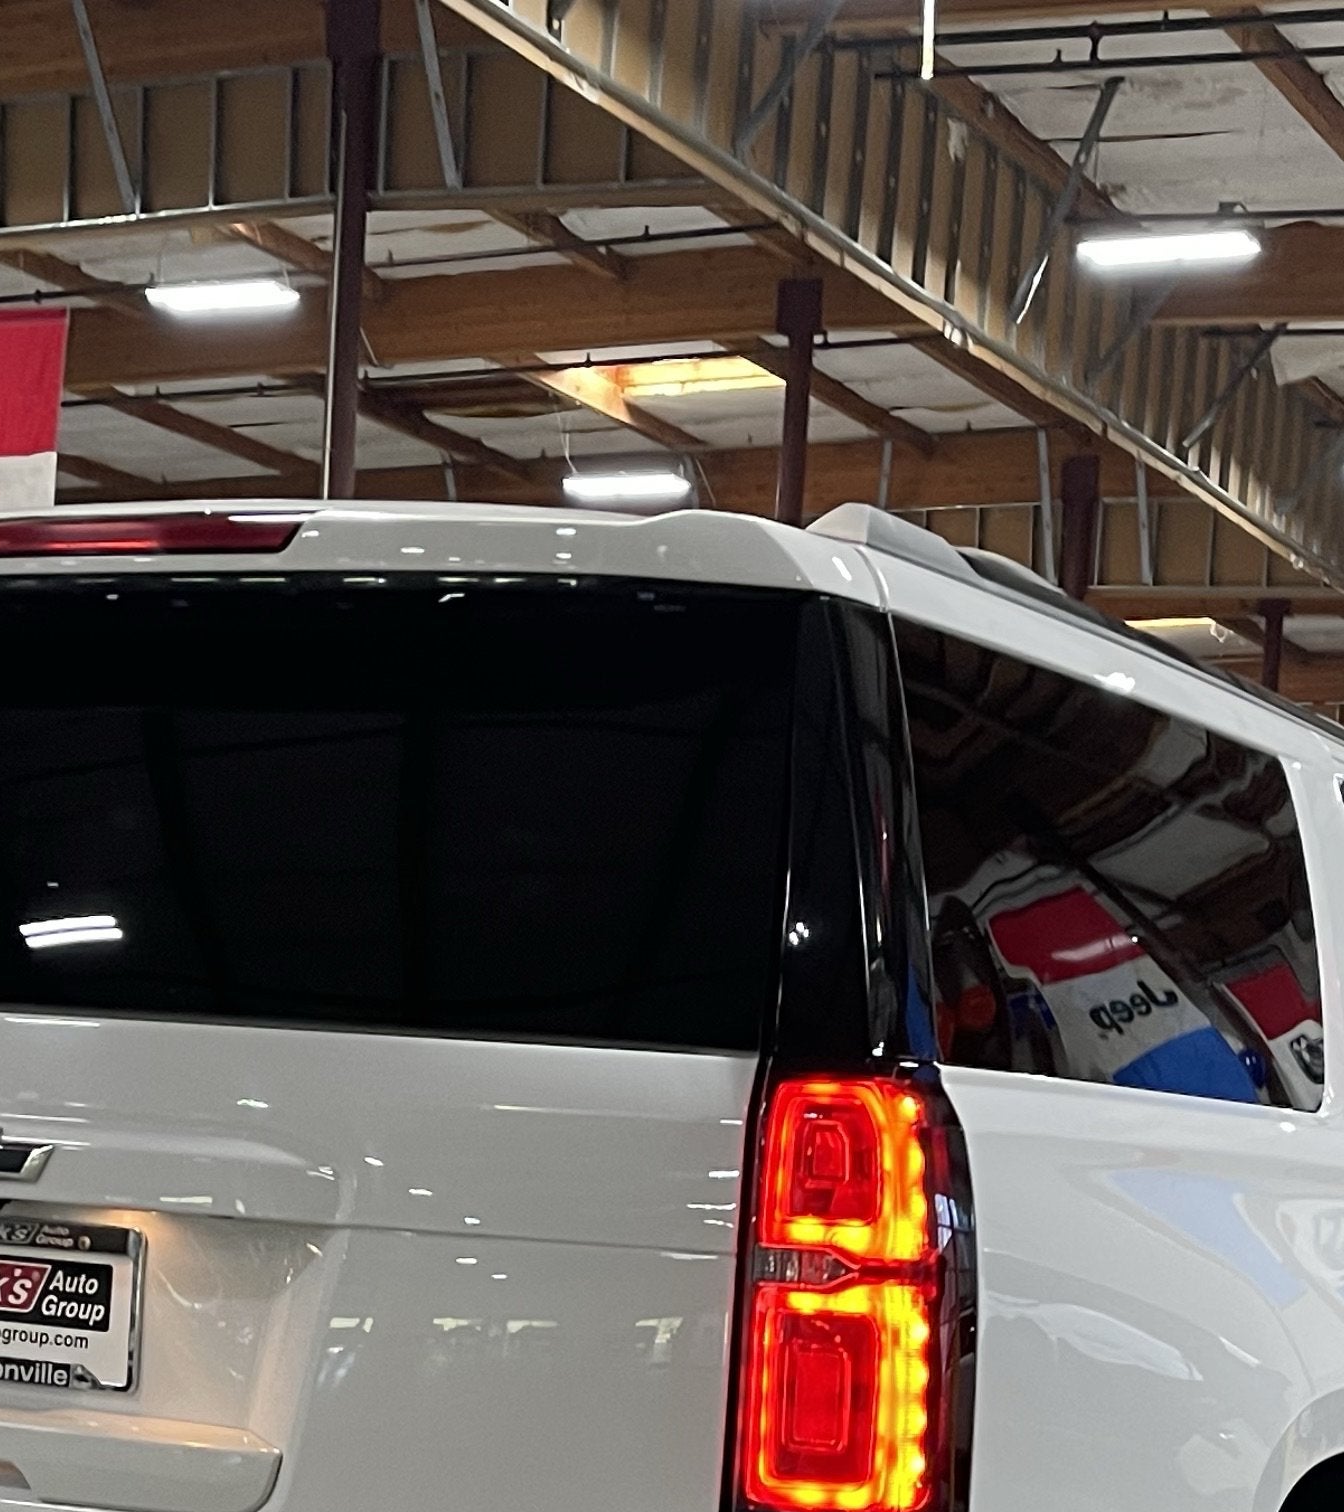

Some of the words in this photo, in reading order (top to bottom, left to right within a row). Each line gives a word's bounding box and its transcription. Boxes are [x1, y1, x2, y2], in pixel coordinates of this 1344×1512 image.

[39, 1225, 70, 1236] Auto
[49, 1270, 99, 1295] Auto
[41, 1294, 106, 1326] Group
